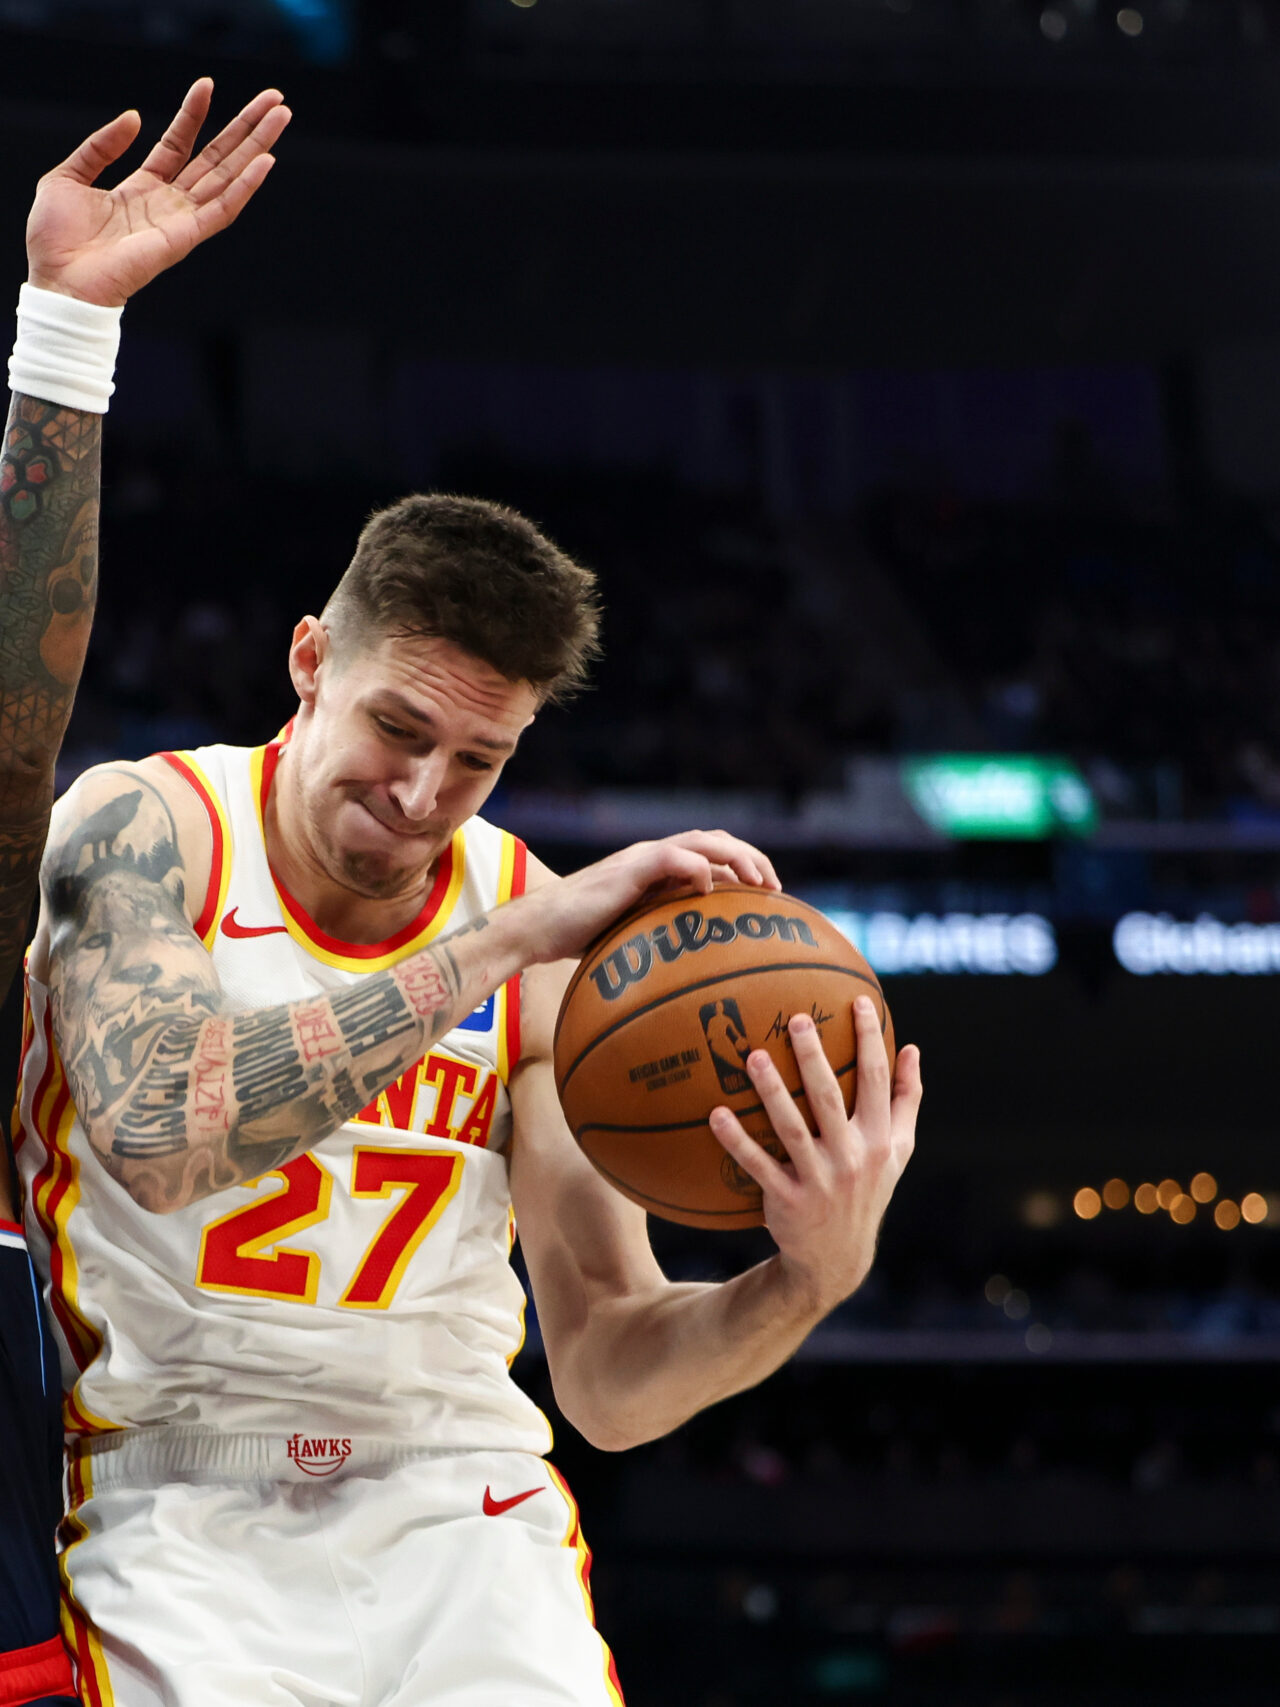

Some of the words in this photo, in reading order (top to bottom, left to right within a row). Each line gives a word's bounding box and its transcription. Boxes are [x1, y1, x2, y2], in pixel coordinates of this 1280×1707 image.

[588, 909, 819, 1002] Wilson
[195, 1144, 466, 1310] 27
[286, 1433, 352, 1458] HAWKS
